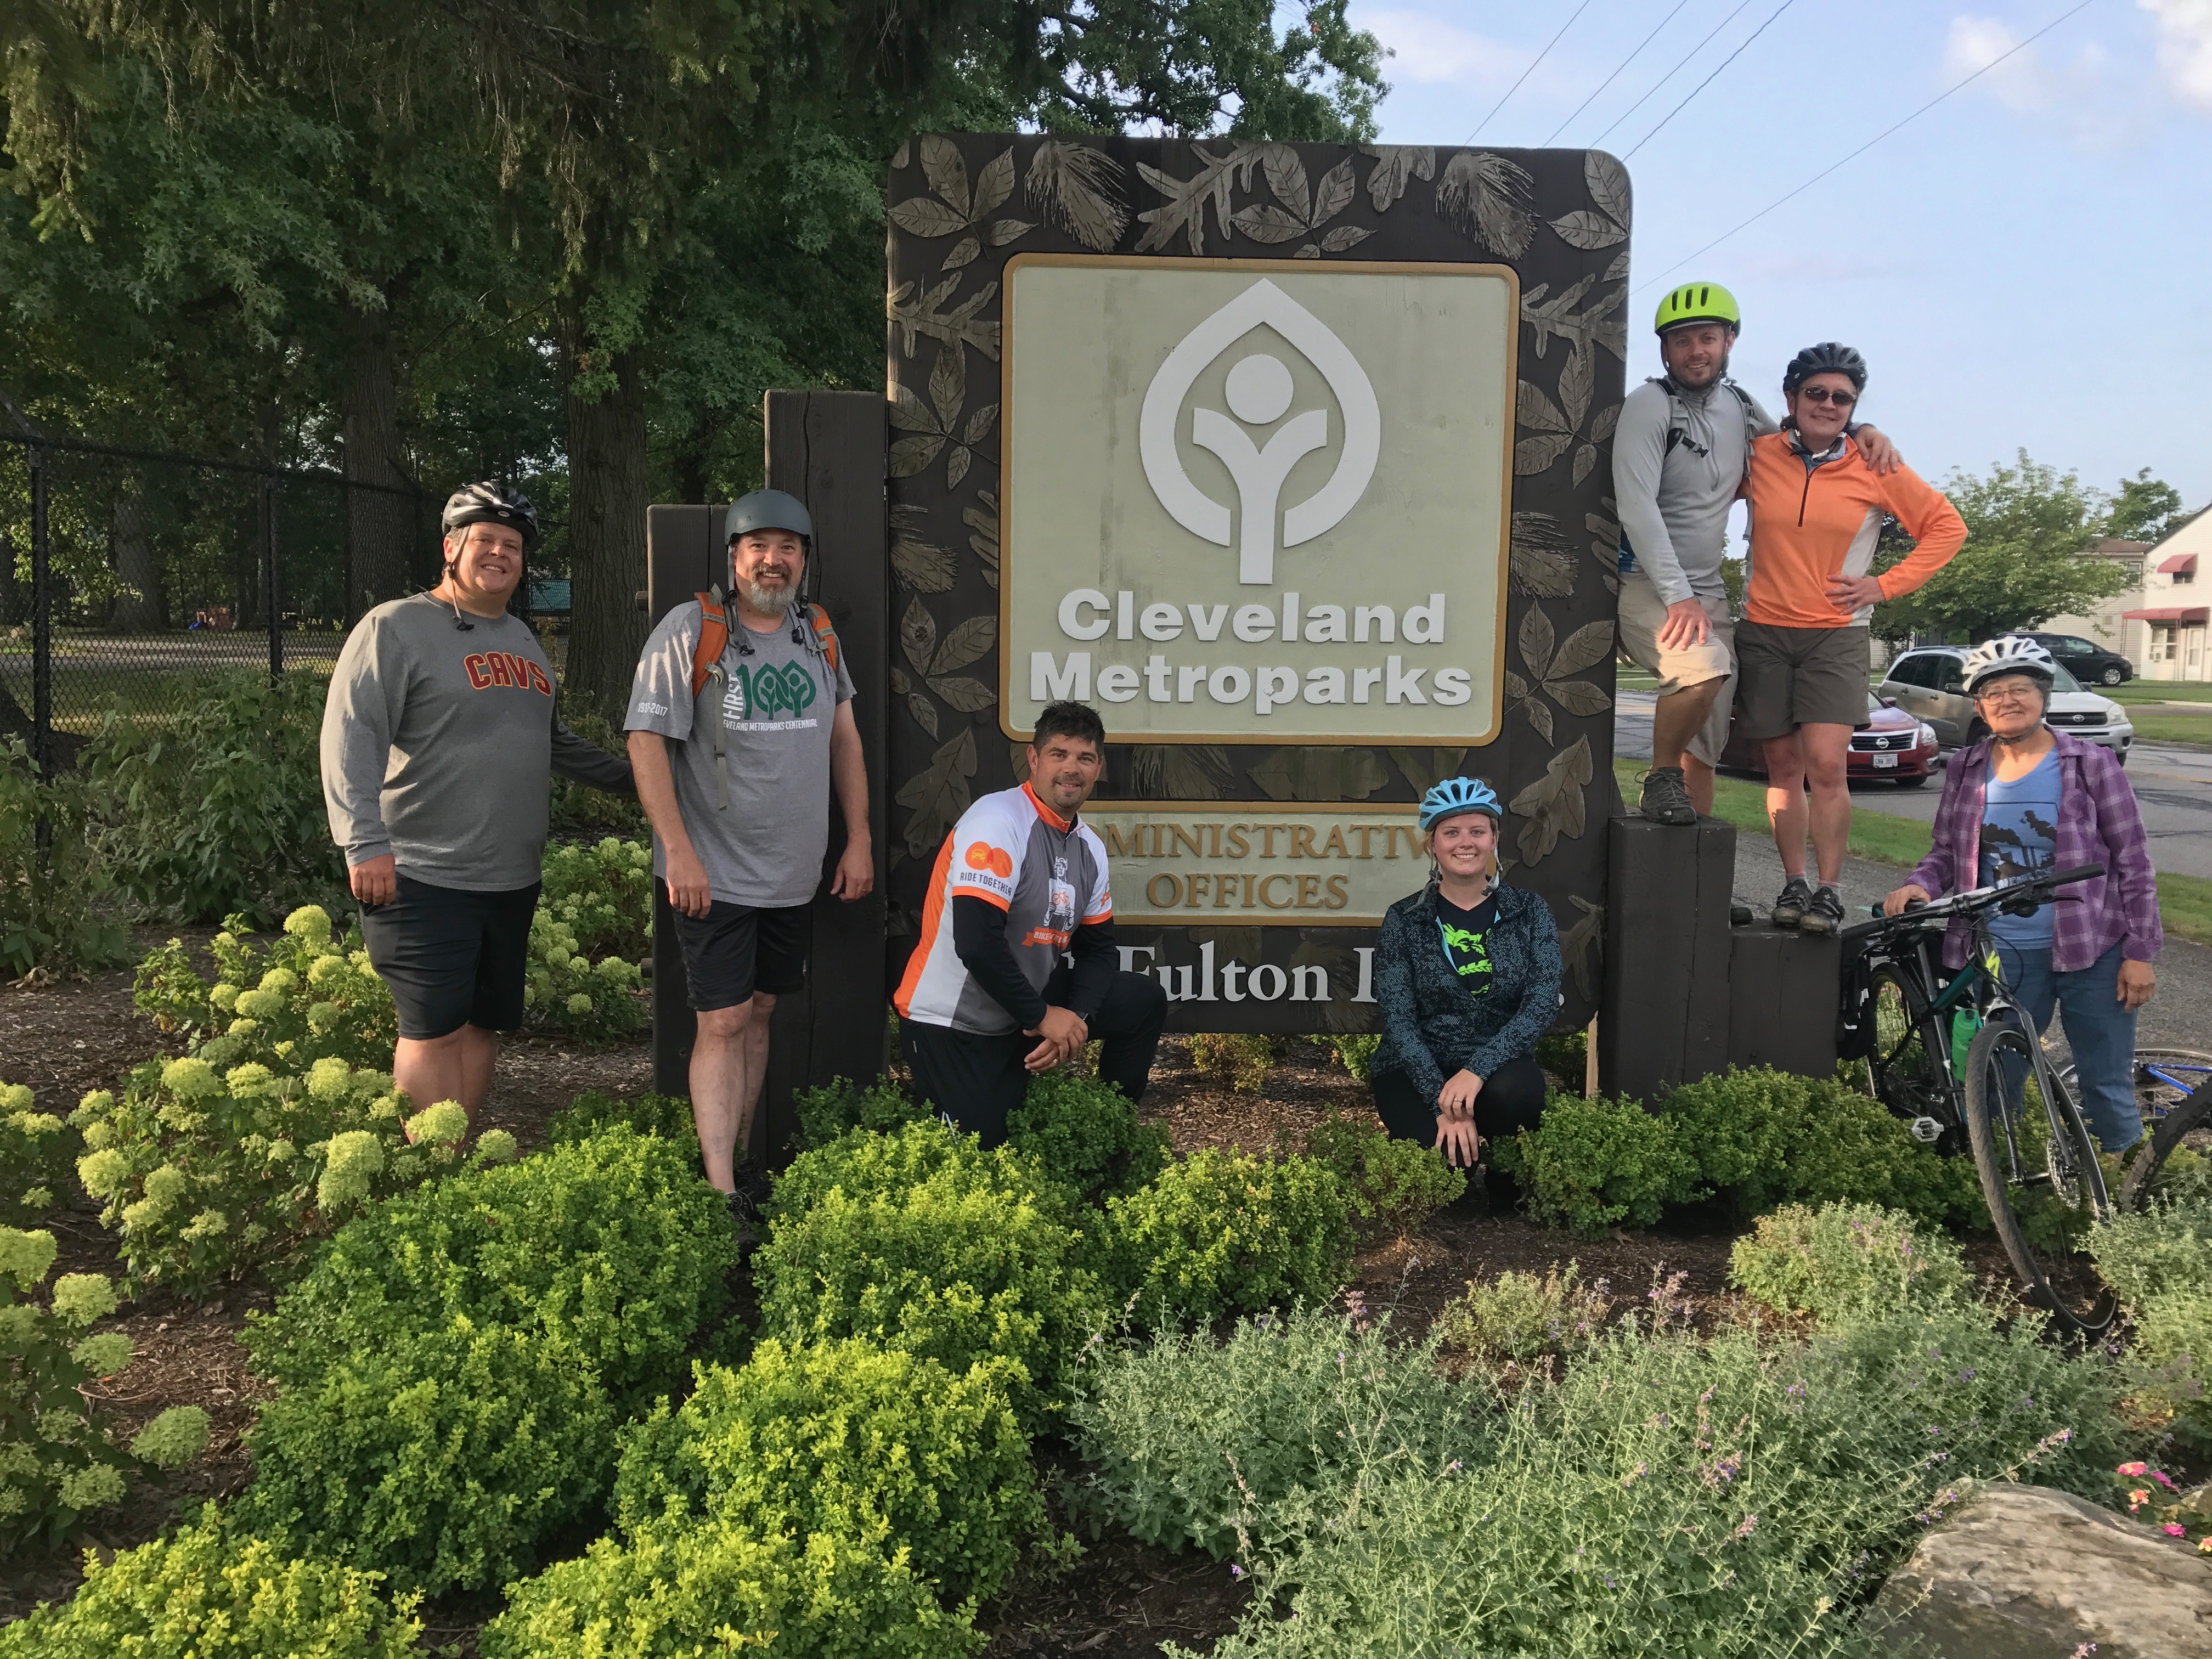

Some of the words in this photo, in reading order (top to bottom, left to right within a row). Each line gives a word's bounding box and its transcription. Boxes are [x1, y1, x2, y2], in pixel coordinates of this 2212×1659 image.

[1058, 589, 1445, 644] Cleveland
[464, 651, 551, 696] CAVS
[1030, 651, 1471, 715] Metroparks
[637, 702, 668, 717] 1917-2017
[723, 719, 748, 731] EVELAND
[749, 722, 785, 731] METROPARKS
[785, 718, 818, 730] CENTENNIAL
[1088, 822, 1425, 860] MINISTRATIV
[960, 872, 977, 882] RIDE
[979, 874, 1012, 896] TOGETHER
[1147, 872, 1349, 910] OFFICES
[1115, 940, 1333, 1002] Fulton
